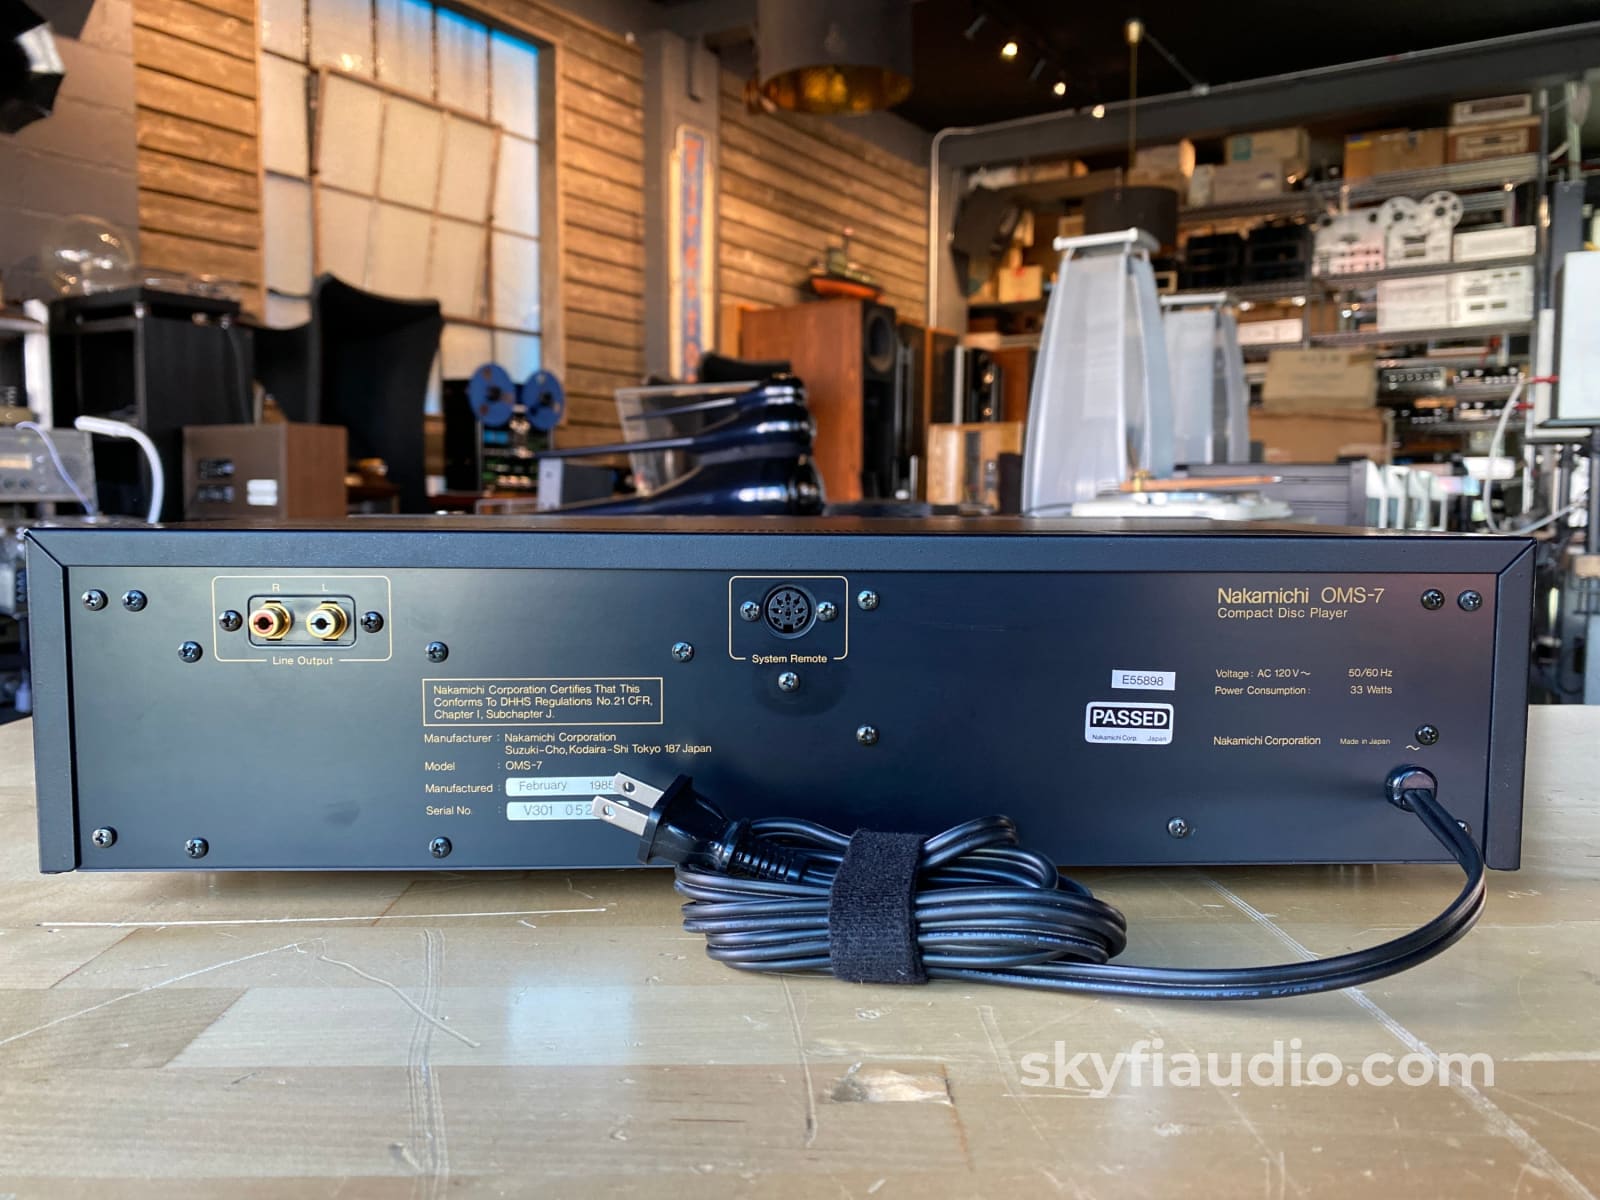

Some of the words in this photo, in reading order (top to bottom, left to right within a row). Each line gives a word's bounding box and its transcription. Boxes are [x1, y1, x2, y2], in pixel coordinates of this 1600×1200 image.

[272, 584, 279, 592] R
[322, 584, 328, 592] L
[1217, 587, 1309, 604] Nakamichi
[1320, 586, 1385, 604] OMS-7
[1217, 607, 1273, 620] Compact
[1278, 607, 1305, 618] Disc
[1310, 607, 1348, 620] Player
[272, 656, 294, 665] Line
[297, 656, 333, 667] Output
[752, 654, 787, 664] System
[790, 654, 828, 663] Remote
[1257, 668, 1272, 678] AC
[1348, 668, 1379, 678] 50/60
[1380, 668, 1393, 677] Hz
[1122, 674, 1164, 686] E55898
[433, 685, 485, 695] Nakamichi
[488, 685, 547, 696] Corporation
[549, 684, 592, 694] Certifies
[594, 684, 616, 694] That
[620, 684, 640, 694] This
[1215, 685, 1244, 695] Power
[1350, 685, 1363, 694] 33
[1367, 685, 1393, 694] Watts
[433, 697, 483, 707] Conforms
[486, 697, 497, 707] To
[500, 696, 531, 707] DHHS
[535, 696, 593, 708] Regulations
[434, 709, 474, 720] Chapter
[486, 709, 544, 720] Subchapter
[1092, 709, 1168, 726] PASSED
[424, 733, 493, 743] Manufacturer
[504, 732, 555, 742] Nakamichi
[558, 732, 616, 743] Corporation
[1213, 735, 1263, 745] Nakamichi
[1264, 735, 1321, 746] Corporation
[1369, 738, 1391, 746] Japan
[632, 744, 661, 755] Tokyo
[664, 744, 681, 753] 187
[682, 744, 712, 754] Japan
[424, 761, 456, 771] Model
[505, 761, 543, 770] OMS-7
[425, 784, 494, 793] Manufactured
[519, 780, 568, 791] February
[426, 805, 455, 816] Serial
[523, 805, 553, 816] V301
